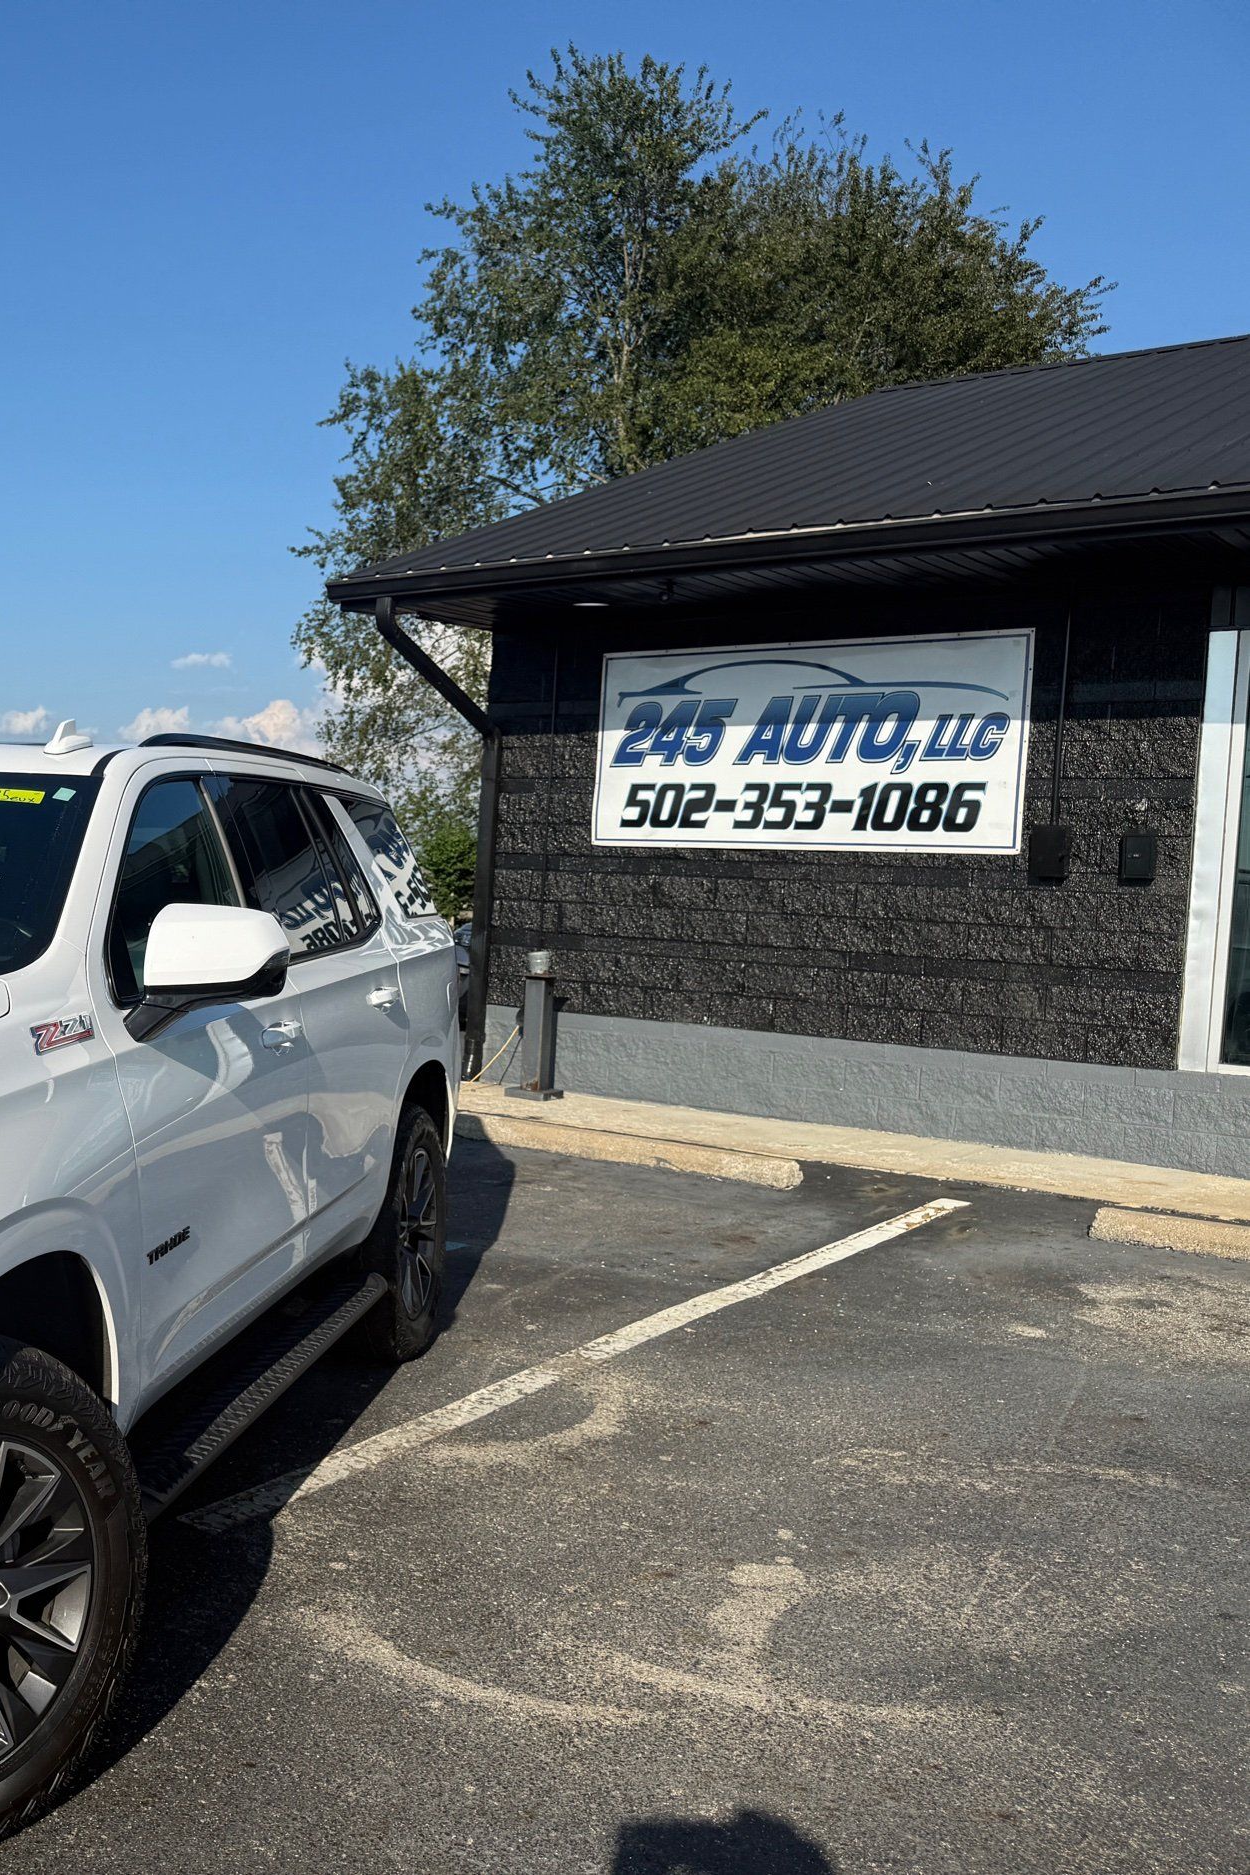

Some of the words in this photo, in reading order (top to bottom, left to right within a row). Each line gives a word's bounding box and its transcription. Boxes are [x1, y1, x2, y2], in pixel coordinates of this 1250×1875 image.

[609, 698, 739, 769] 245
[733, 691, 922, 775] AUTO,
[920, 712, 1011, 762] LLC
[619, 781, 989, 833] 502-353-1086
[30, 1014, 95, 1055] Z71
